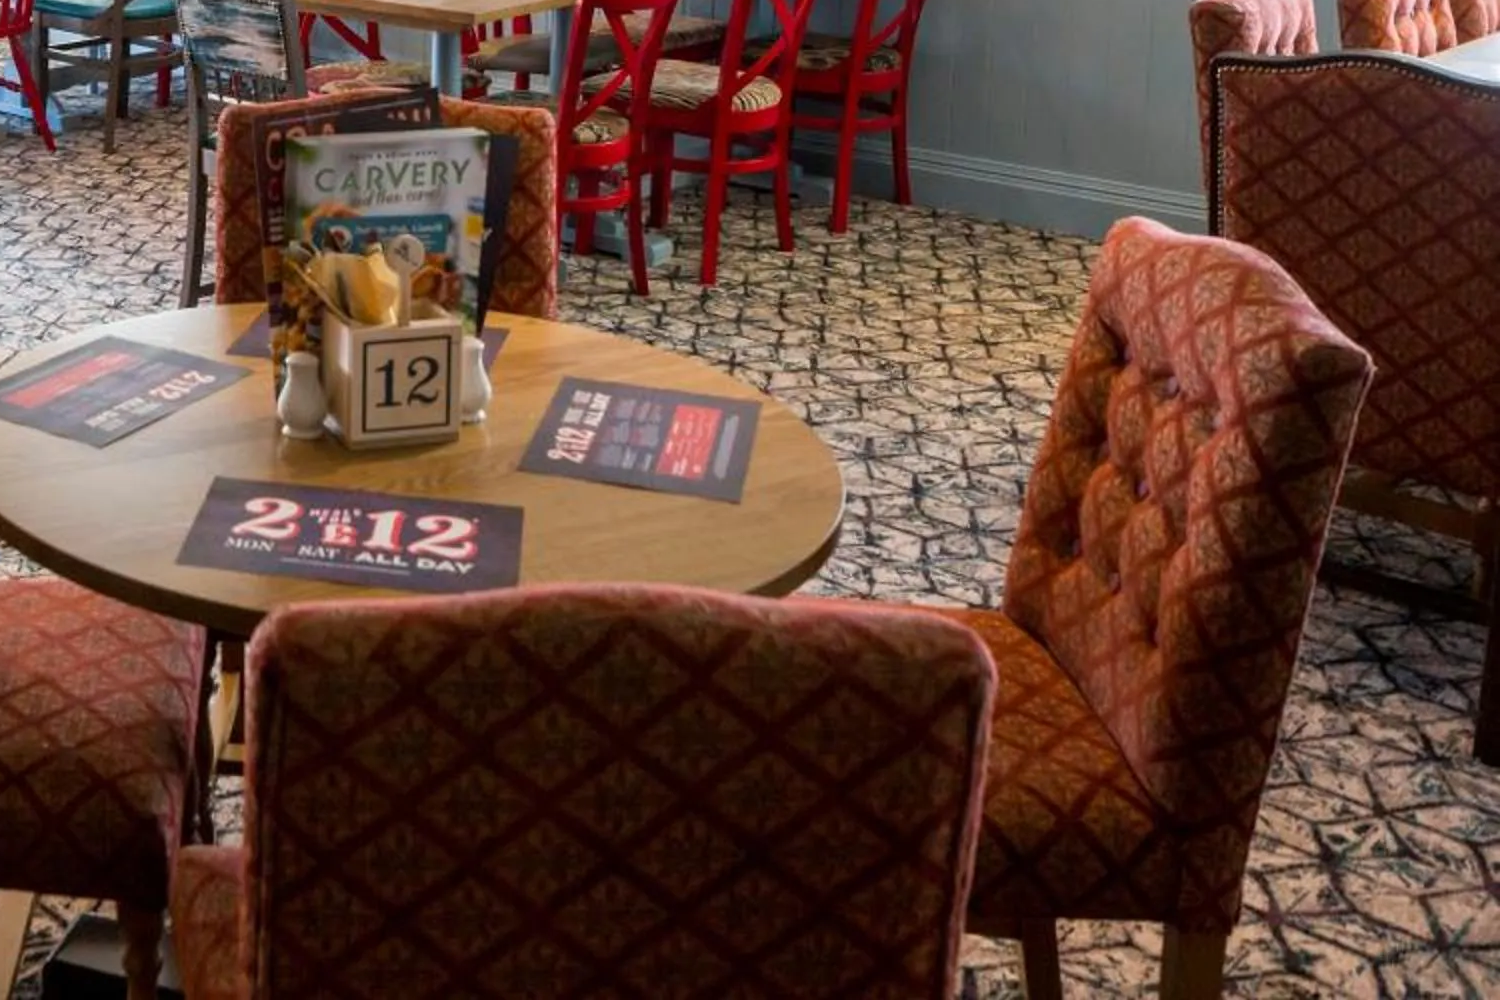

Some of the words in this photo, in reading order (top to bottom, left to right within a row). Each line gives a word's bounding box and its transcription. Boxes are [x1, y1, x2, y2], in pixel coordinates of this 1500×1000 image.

[315, 158, 470, 193] CARVERY
[374, 355, 440, 408] 12
[232, 497, 302, 539] 2
[225, 536, 275, 553] MON
[298, 544, 341, 561] SAT
[354, 551, 409, 568] ALL
[416, 557, 475, 576] DAY
